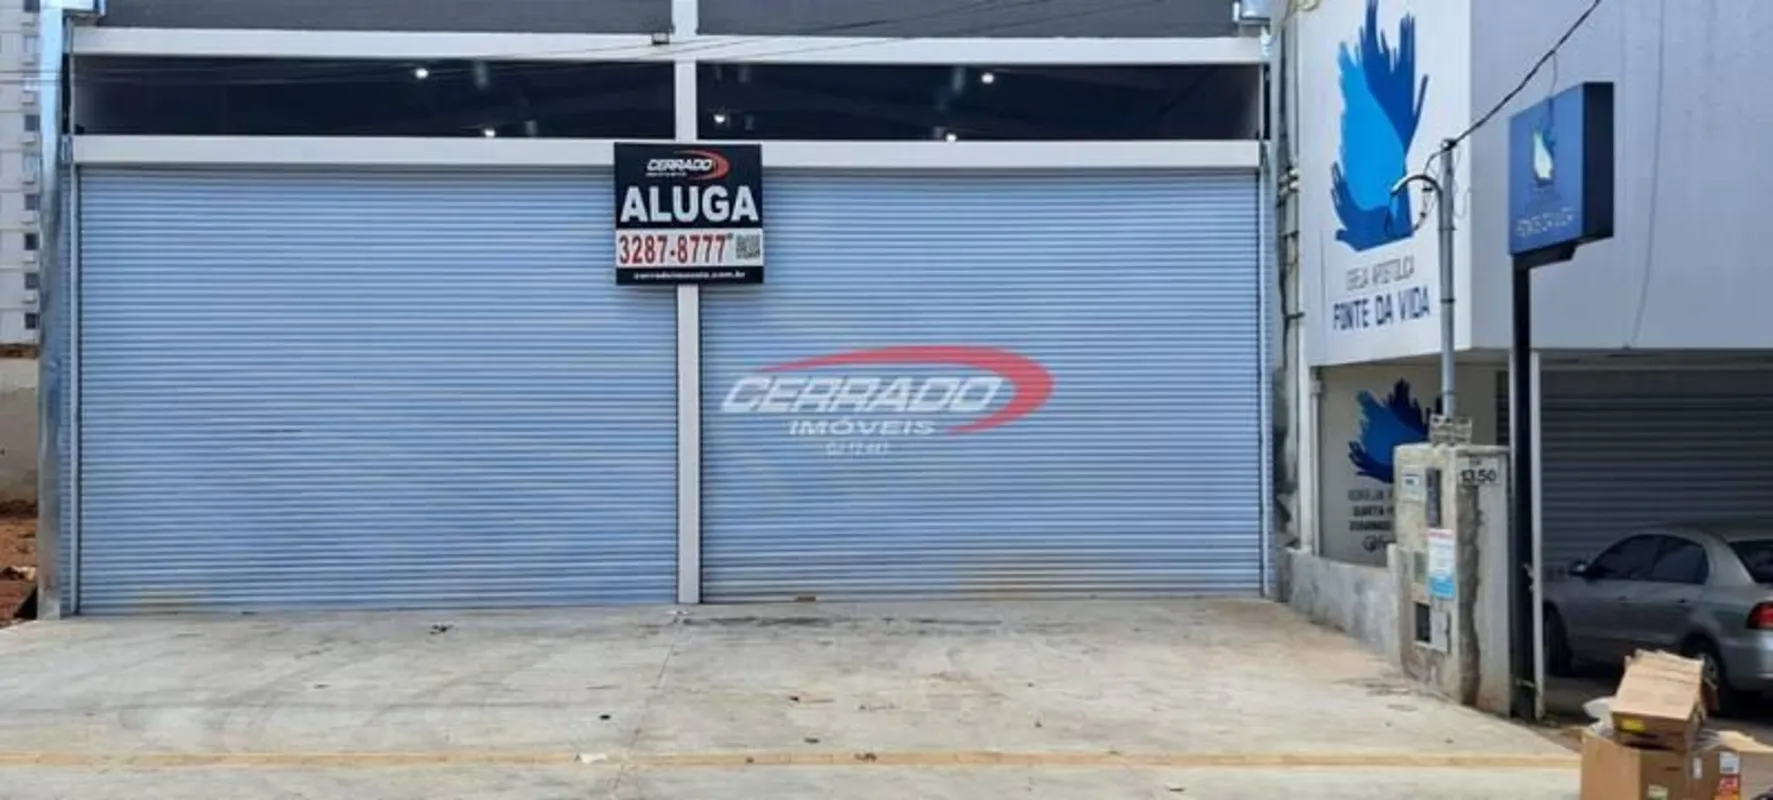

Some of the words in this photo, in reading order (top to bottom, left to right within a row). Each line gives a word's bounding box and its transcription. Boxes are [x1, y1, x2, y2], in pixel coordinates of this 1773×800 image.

[647, 159, 713, 172] CERRADO
[620, 185, 760, 222] ALUGA
[1333, 298, 1369, 330] FONTE
[1376, 293, 1393, 325] DA
[1398, 286, 1430, 321] VIDA
